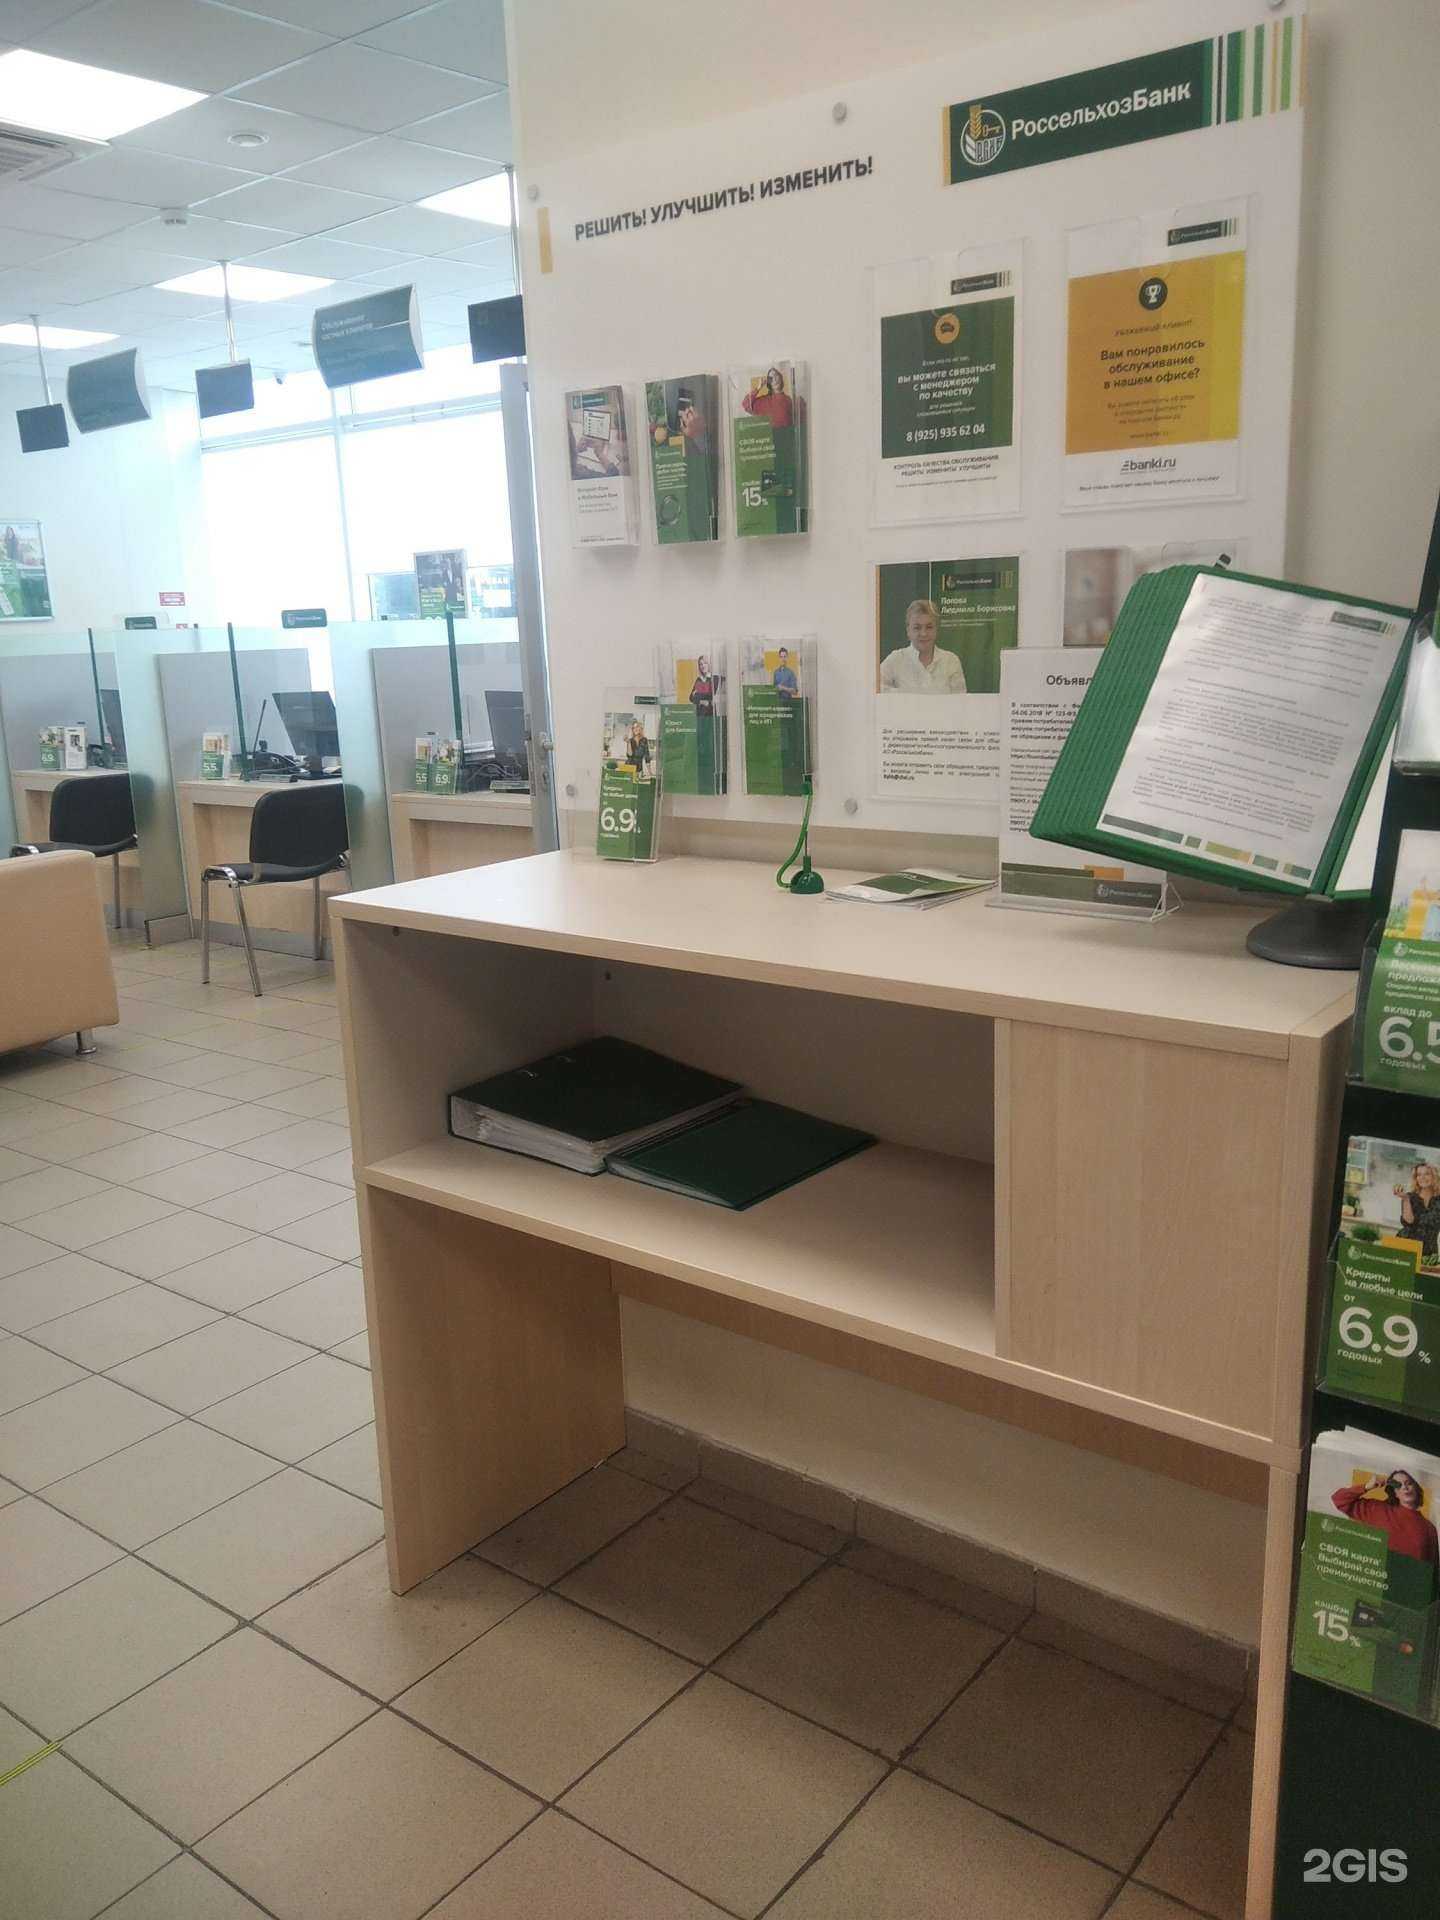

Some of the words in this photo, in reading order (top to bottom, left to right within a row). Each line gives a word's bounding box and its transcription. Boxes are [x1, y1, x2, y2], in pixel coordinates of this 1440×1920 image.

[1012, 82, 1191, 140] РоссельхозБанк
[575, 210, 646, 240] РЕШИТЬ!
[650, 184, 754, 223] УЛУЧШИТЬ!
[760, 156, 872, 198] ИЗМЕНИТЬ!
[1101, 350, 1123, 360] Вам
[1127, 340, 1205, 357] понравилось
[897, 376, 910, 384] вы
[913, 370, 947, 381] можете
[949, 363, 996, 376] связаться
[1109, 356, 1194, 374] обслуживание
[921, 376, 979, 390] менеджером
[1114, 374, 1152, 387] нашем
[1156, 368, 1200, 383] офисе?
[933, 387, 973, 399] качеству
[906, 432, 912, 442] 8
[915, 429, 937, 443] (925)
[940, 427, 957, 438] 935
[960, 426, 970, 436] 62
[973, 424, 985, 434] 04
[1130, 458, 1176, 471] banki.ru
[941, 606, 975, 614] Людмила
[1384, 1005, 1416, 1017] вклад
[1380, 1057, 1426, 1071] годовых
[1345, 1267, 1391, 1283] Кредиты
[1344, 1294, 1355, 1302] от
[1345, 1280, 1357, 1288] на
[1359, 1282, 1395, 1295] любые
[1398, 1289, 1424, 1301] цели
[1337, 1349, 1383, 1364] годовых
[1319, 1542, 1349, 1556] СВОЯ
[1318, 1553, 1363, 1573] Выбирай
[1316, 1564, 1389, 1591] преимущество
